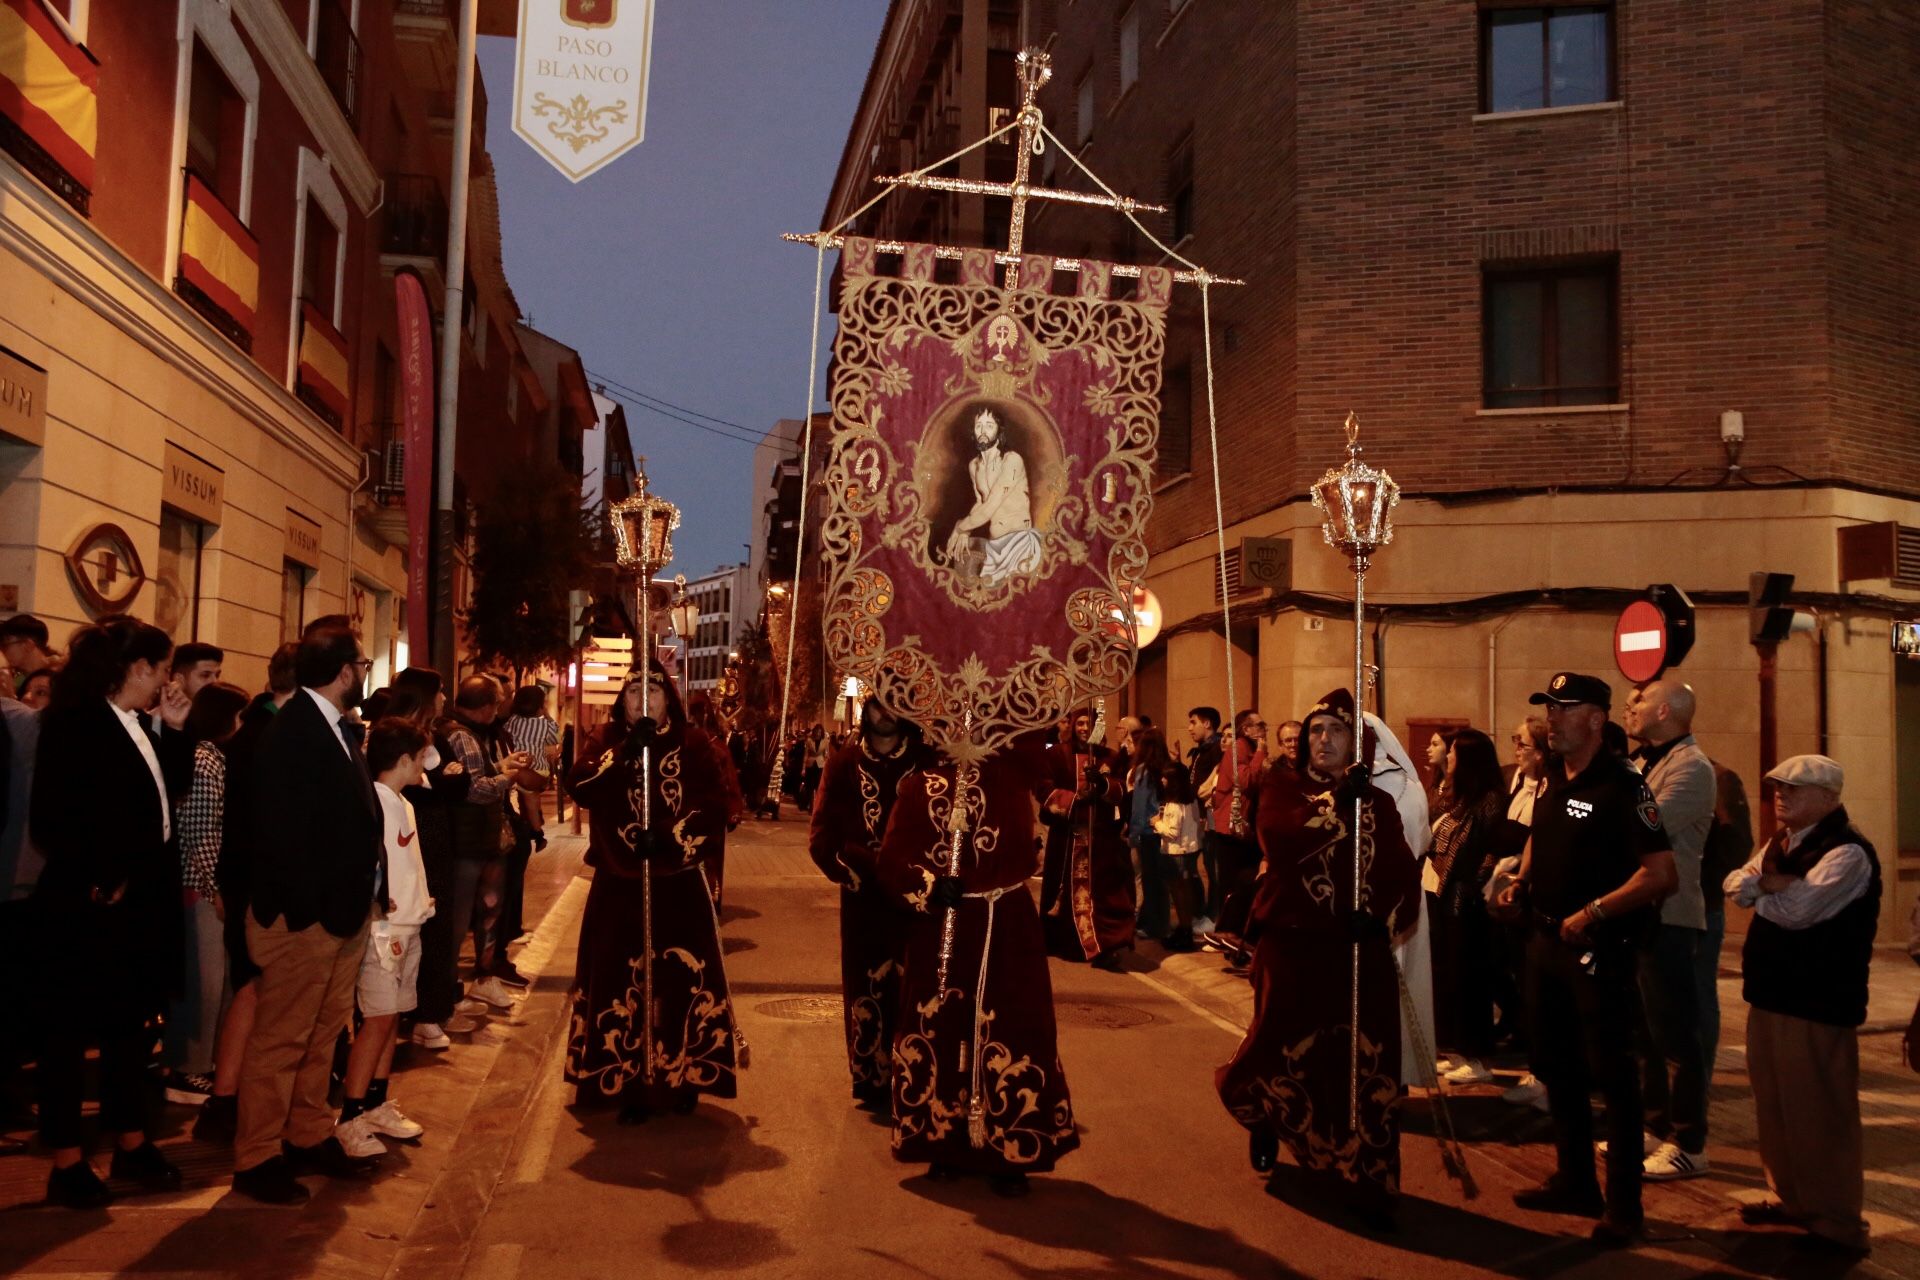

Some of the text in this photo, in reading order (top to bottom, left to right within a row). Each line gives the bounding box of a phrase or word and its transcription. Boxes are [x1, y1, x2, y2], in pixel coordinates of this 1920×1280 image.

[557, 35, 613, 57] PASO
[536, 59, 629, 84] BLANCO
[172, 464, 217, 506] VISSUM
[288, 525, 318, 551] VISSUM
[1567, 798, 1593, 812] POLICIA
